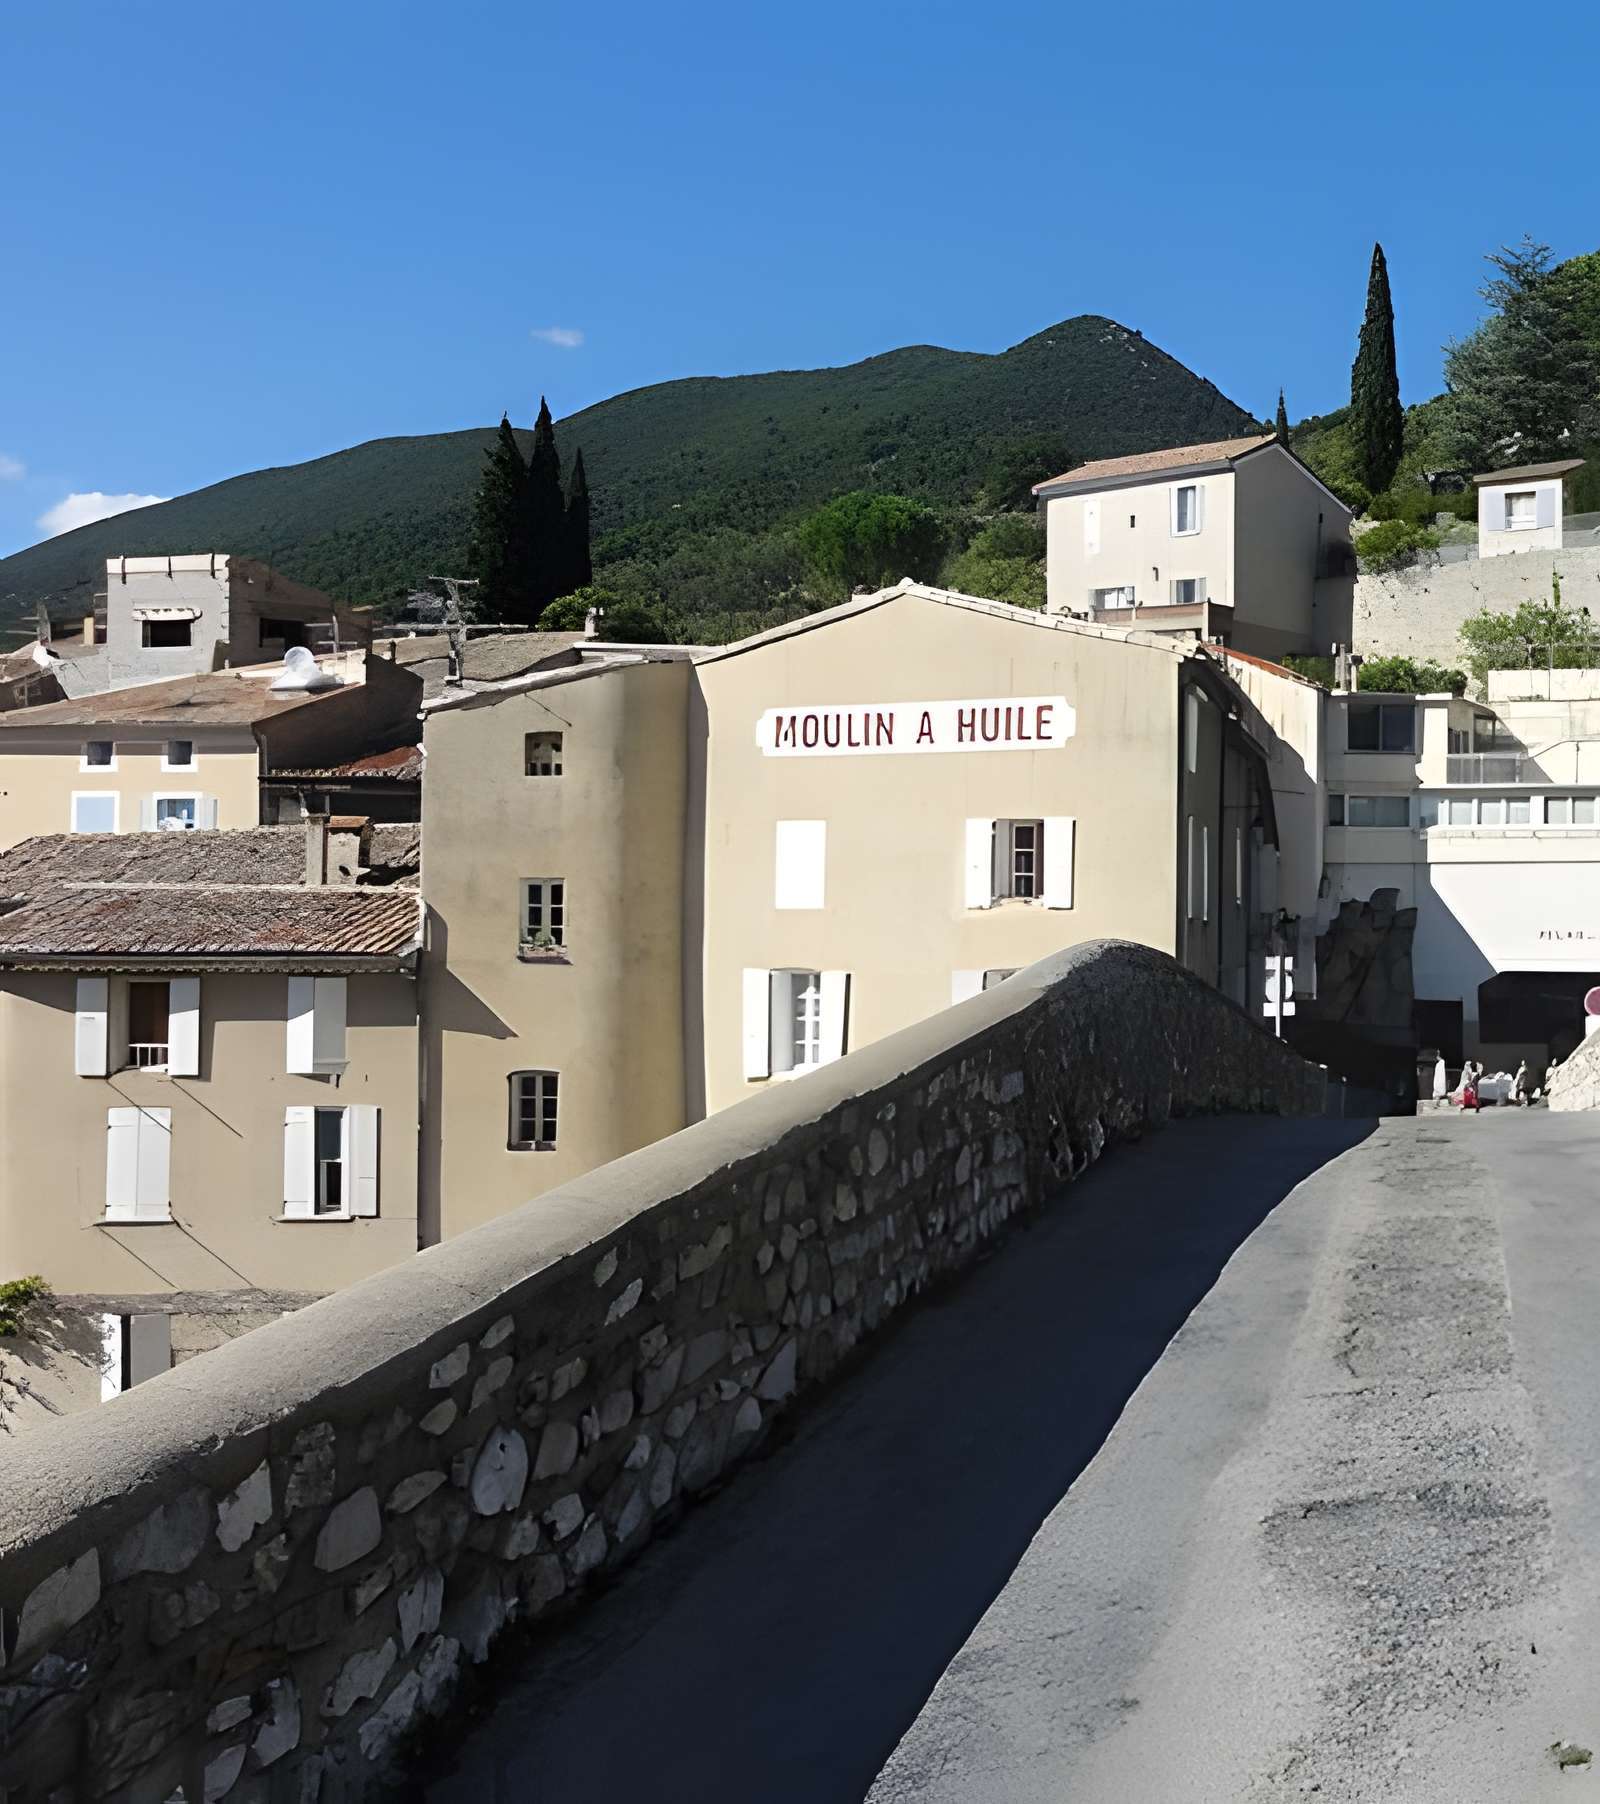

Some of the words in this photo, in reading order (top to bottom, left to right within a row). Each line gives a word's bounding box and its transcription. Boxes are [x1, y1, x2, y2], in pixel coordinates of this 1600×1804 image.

[774, 712, 894, 748] MOULIN
[916, 711, 935, 745] A
[957, 704, 1054, 743] HUILE
